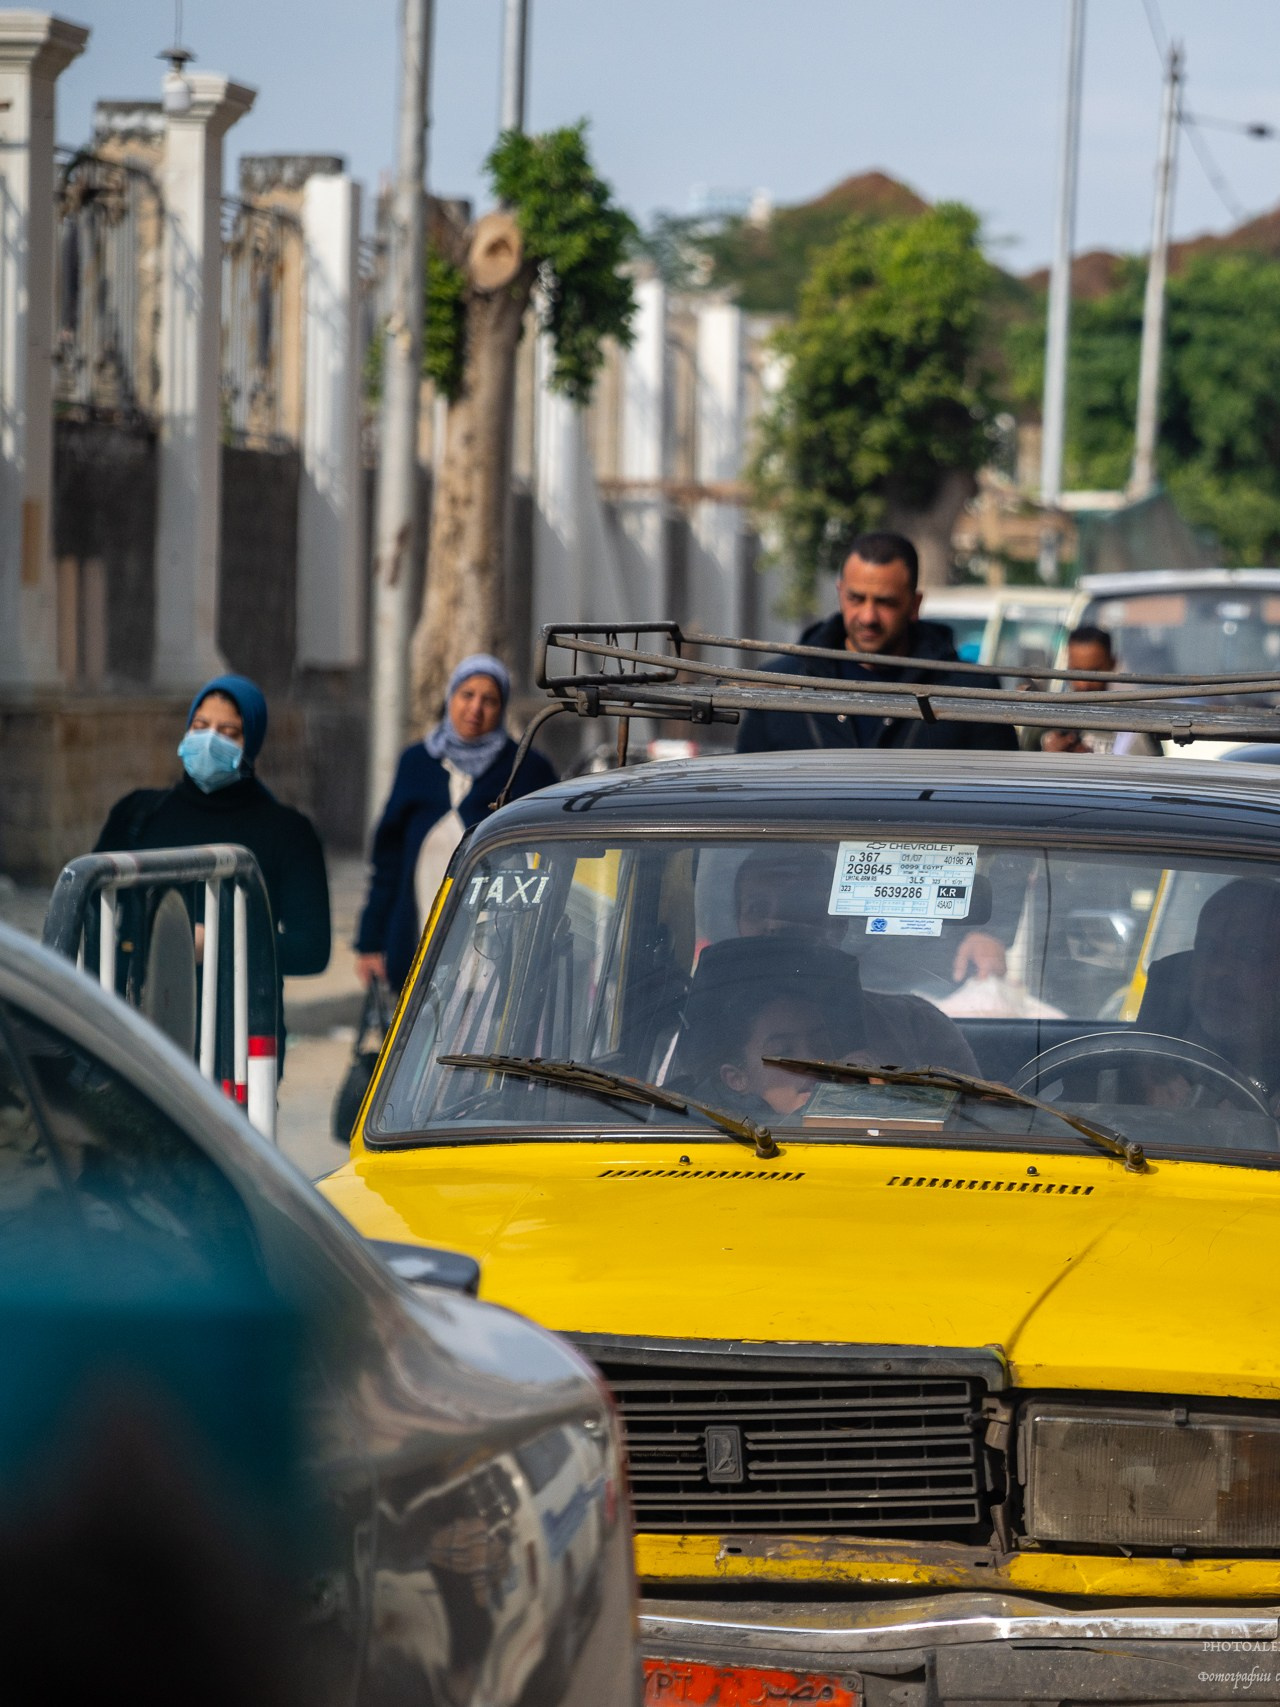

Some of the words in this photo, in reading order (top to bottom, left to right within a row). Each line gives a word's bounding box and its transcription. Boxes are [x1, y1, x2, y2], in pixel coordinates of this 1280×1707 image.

[889, 843, 955, 851] CHEVROLET
[859, 852, 880, 862] 367
[901, 854, 922, 862] 01/07
[944, 856, 964, 865] 40196
[966, 857, 974, 866] A
[846, 863, 892, 875] 2G9645
[469, 876, 549, 904] TAXI
[874, 886, 922, 898] 5639286
[939, 887, 957, 897] K.R
